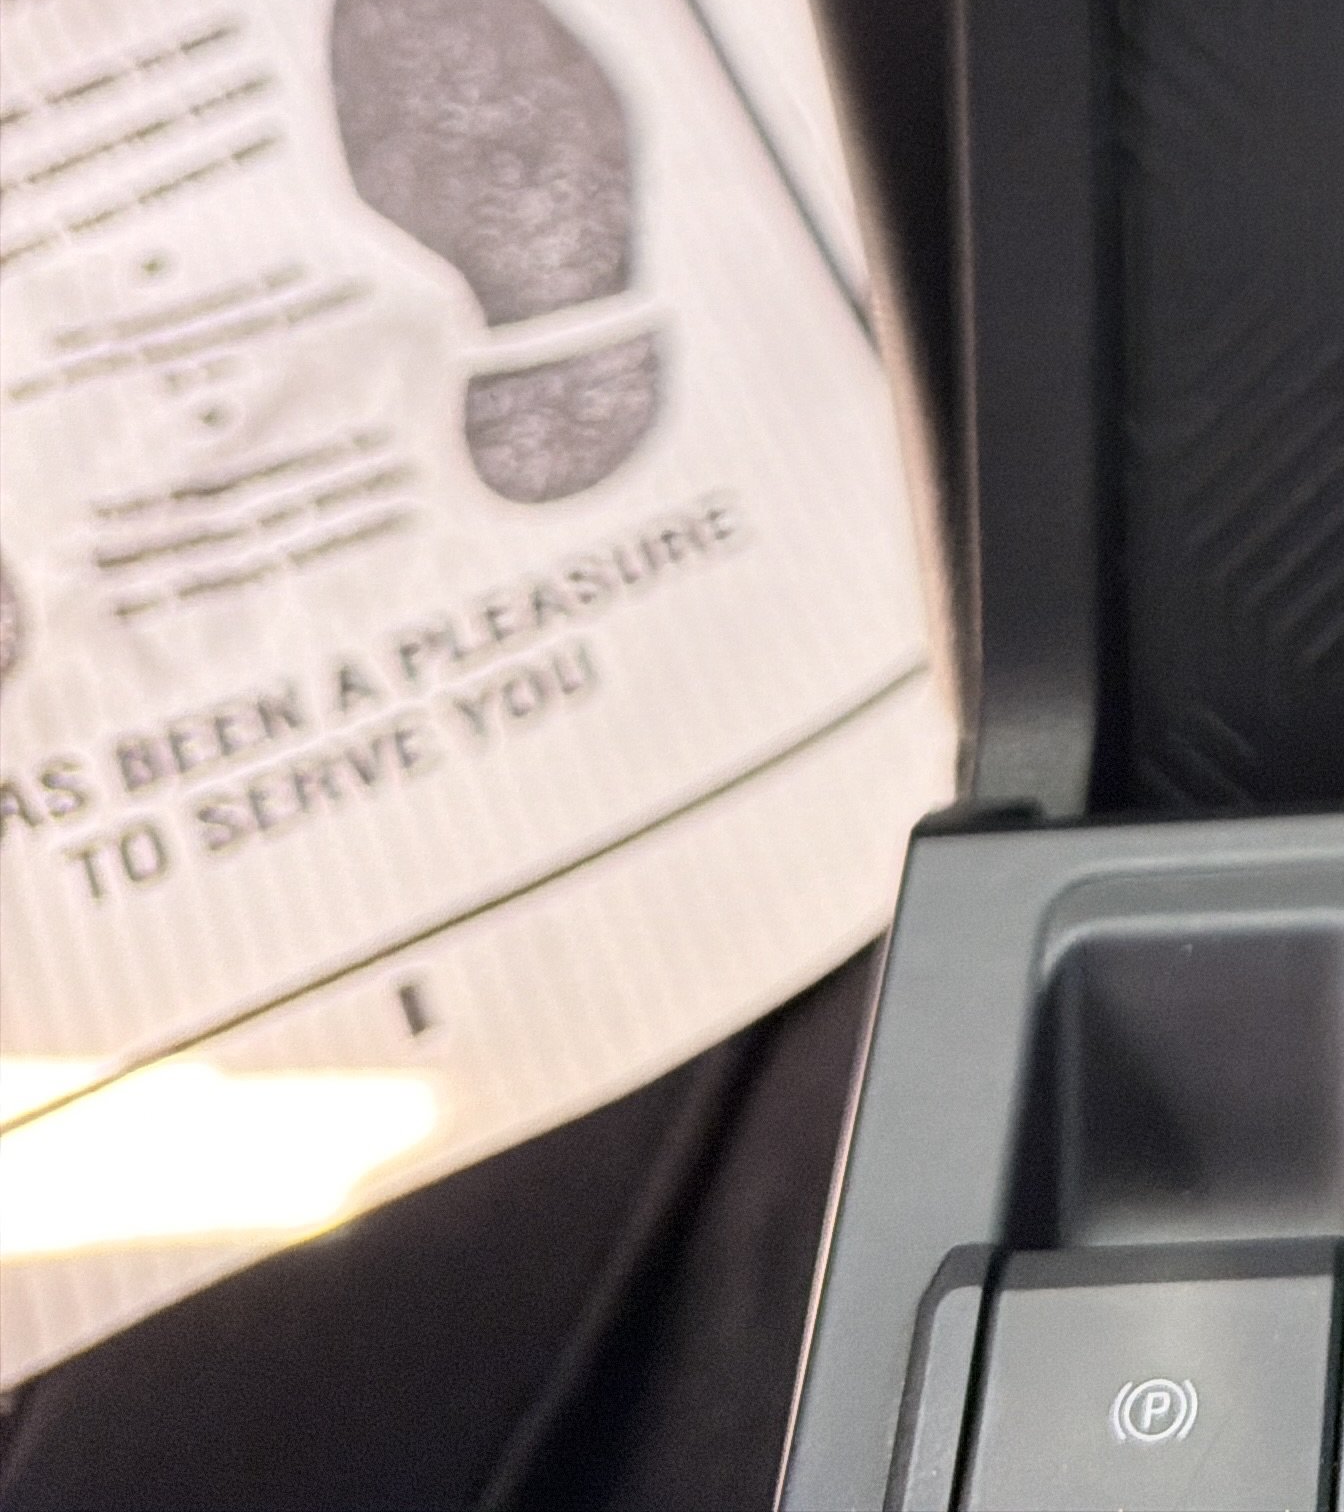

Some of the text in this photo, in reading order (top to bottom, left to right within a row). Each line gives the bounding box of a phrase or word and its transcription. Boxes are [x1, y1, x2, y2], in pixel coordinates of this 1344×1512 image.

[64, 638, 602, 900] TO SERVE YOU
[115, 686, 303, 793] BEEN
[337, 660, 379, 712] A
[399, 502, 741, 684] PLEASURE
